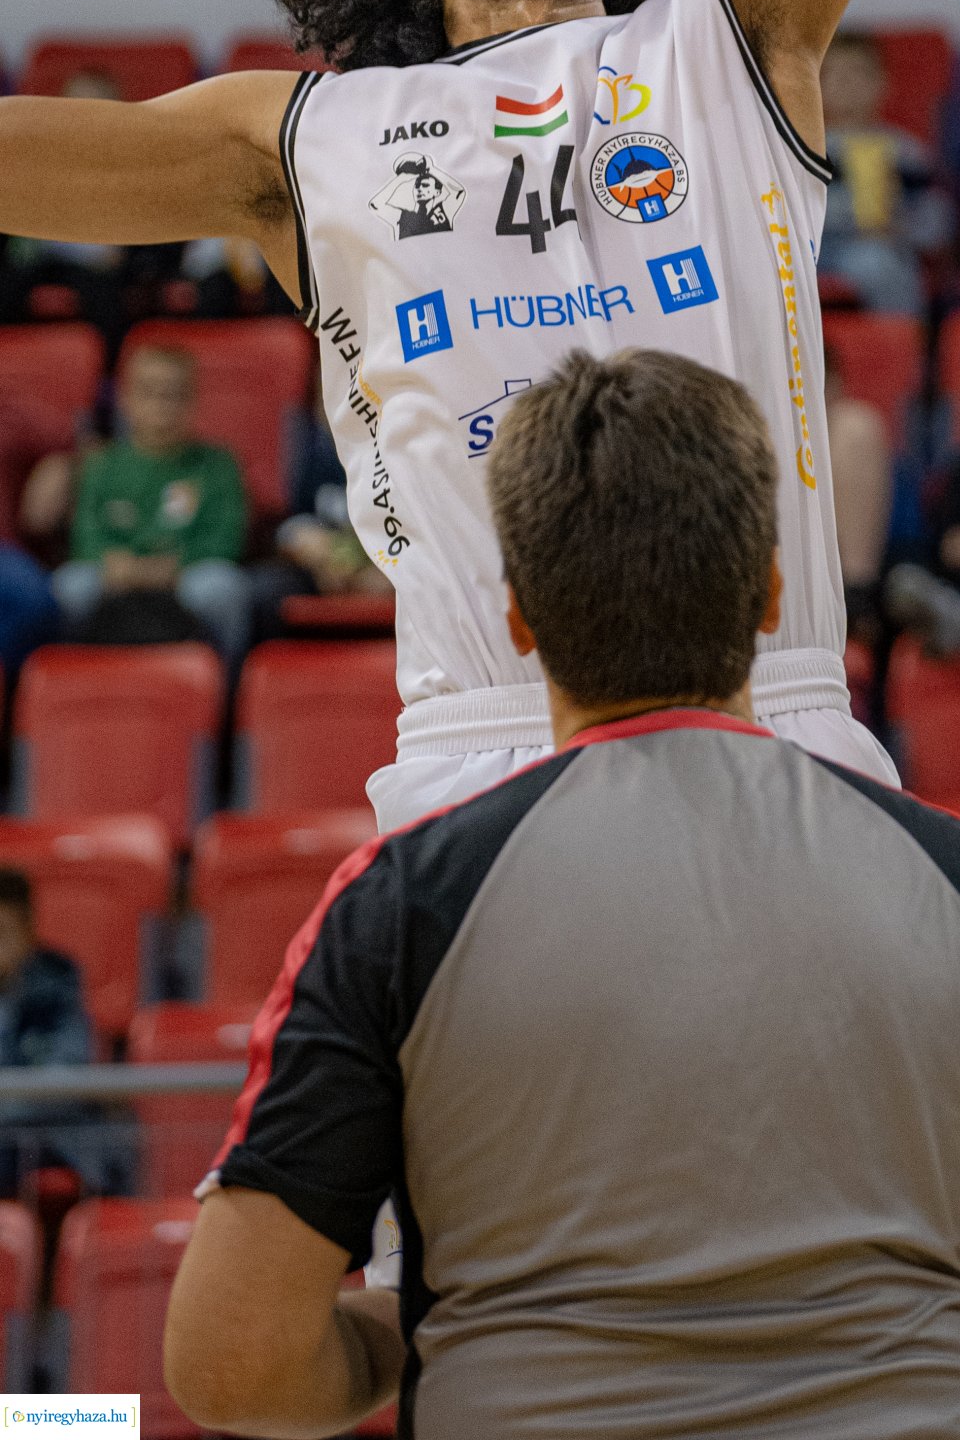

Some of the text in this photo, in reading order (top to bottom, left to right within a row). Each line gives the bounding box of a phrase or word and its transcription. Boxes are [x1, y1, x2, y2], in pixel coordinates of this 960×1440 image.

[379, 120, 449, 146] JAKO
[675, 169, 686, 183] BS
[470, 284, 636, 330] HÜBNER
[320, 306, 361, 363] FM
[373, 488, 411, 557] 99.4
